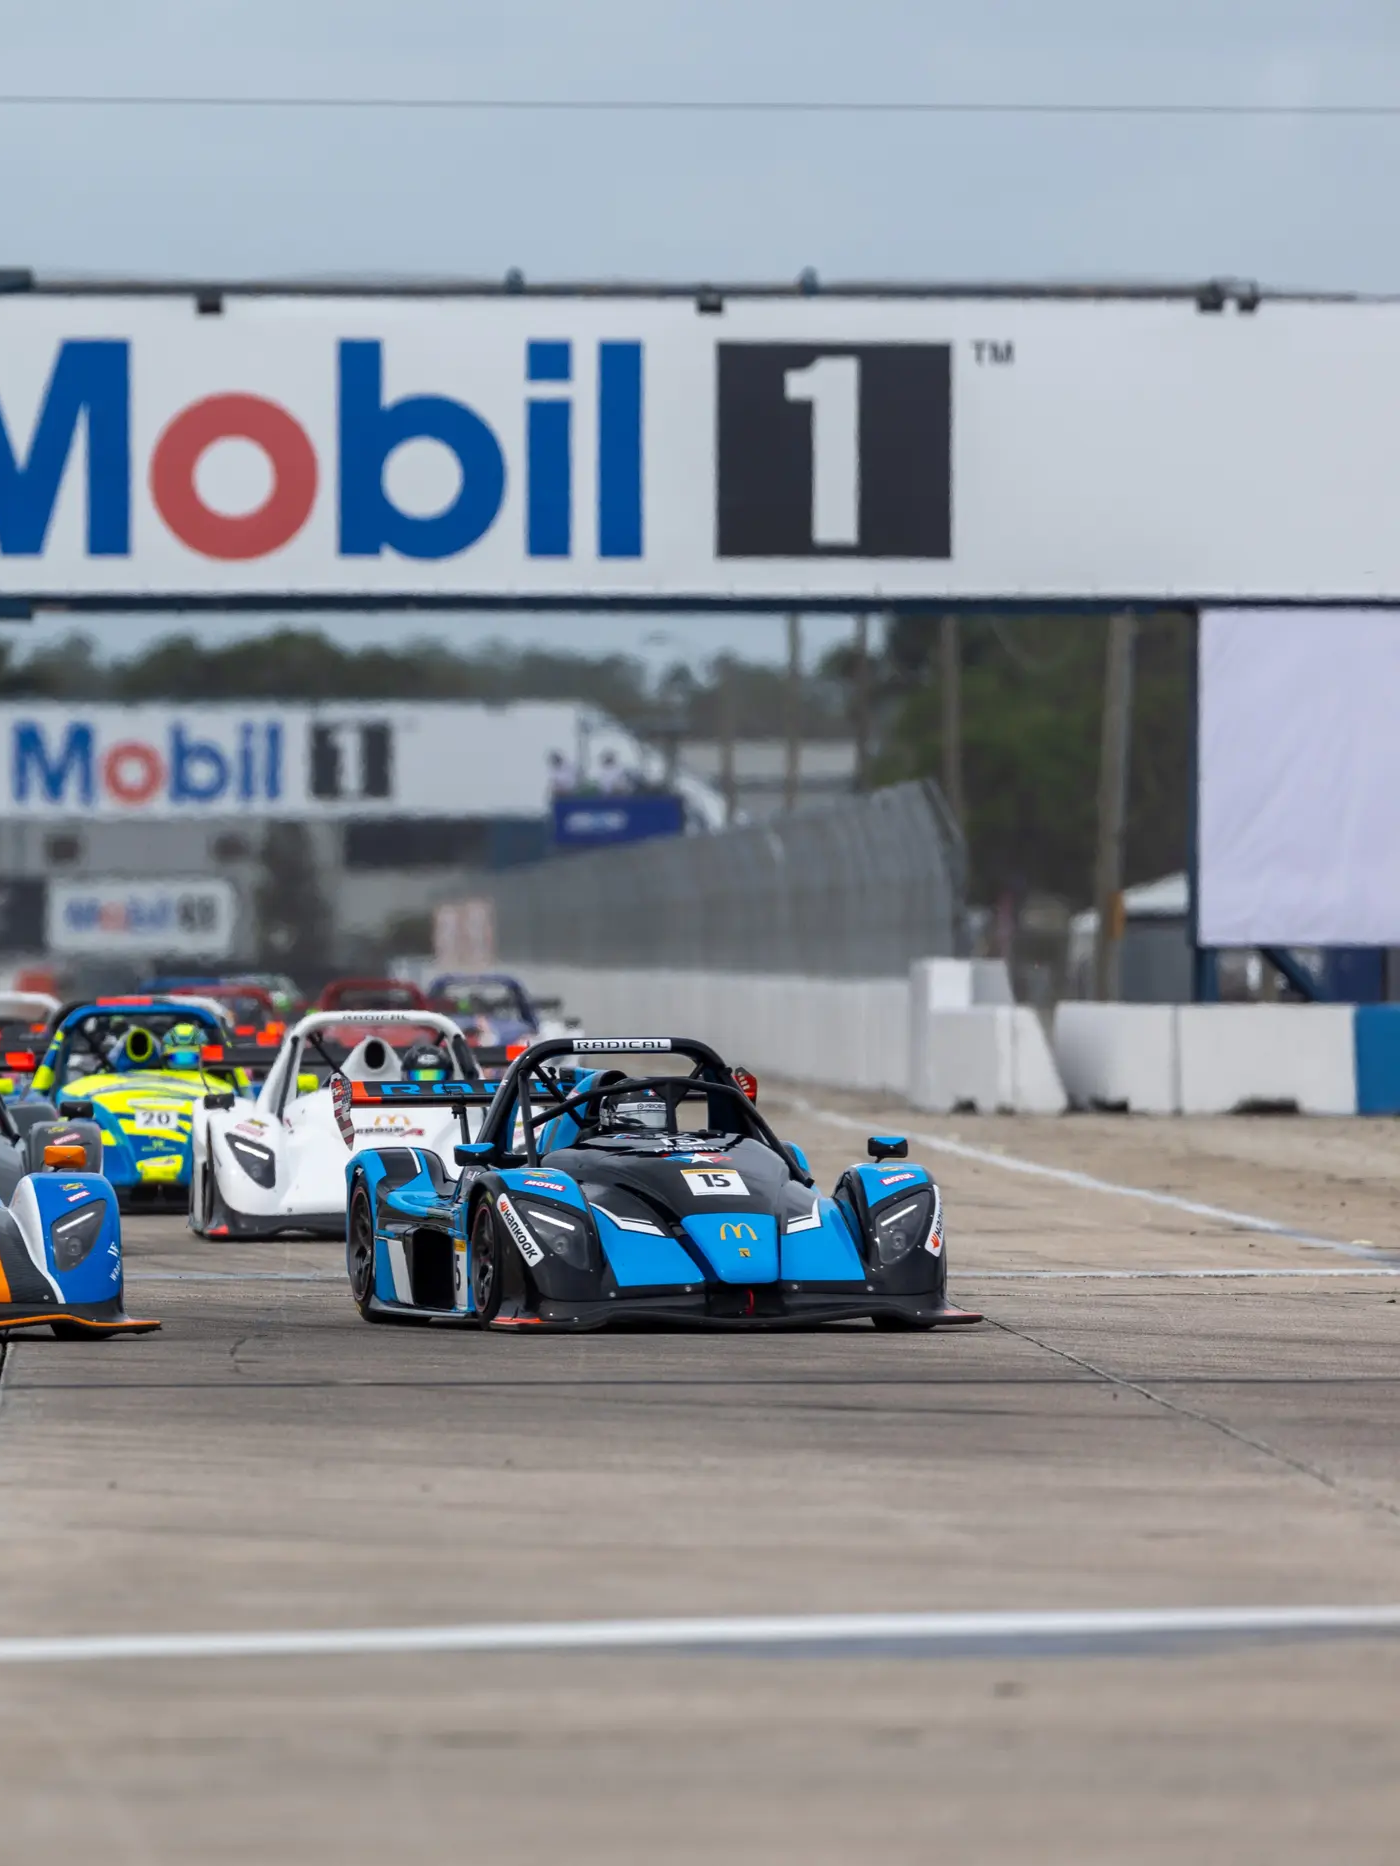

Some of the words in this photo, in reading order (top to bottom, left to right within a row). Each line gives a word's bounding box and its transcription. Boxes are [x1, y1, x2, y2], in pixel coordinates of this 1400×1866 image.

[784, 356, 860, 545] 1
[11, 718, 286, 804] Mobil
[577, 1040, 669, 1050] RADICAL
[524, 1181, 566, 1192] MOTUL
[696, 1173, 732, 1188] 15
